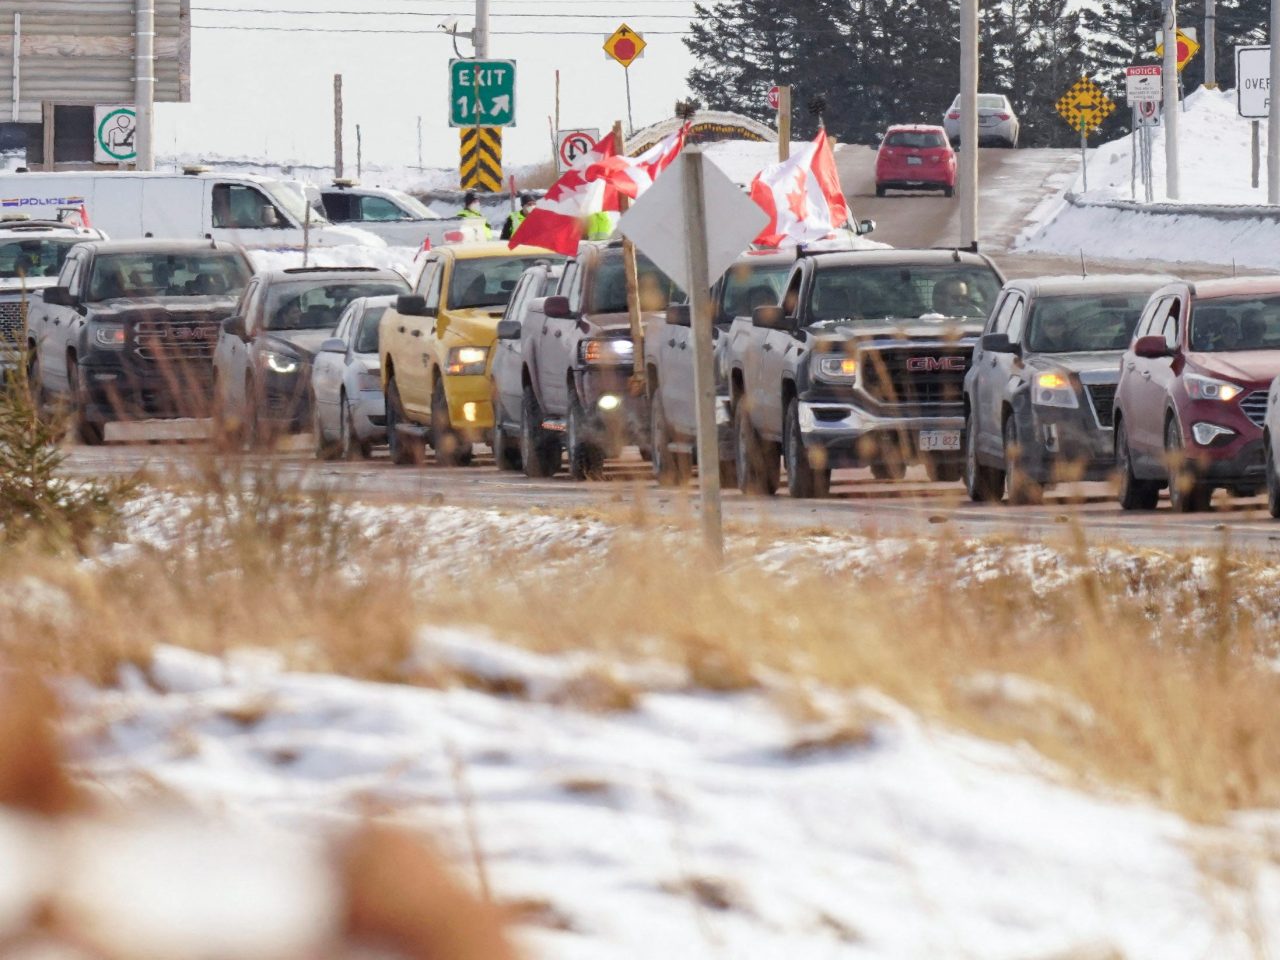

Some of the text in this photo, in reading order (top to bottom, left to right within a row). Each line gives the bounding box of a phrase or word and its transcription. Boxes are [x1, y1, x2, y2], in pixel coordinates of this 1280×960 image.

[458, 69, 506, 87] EXIT
[1129, 67, 1158, 76] NOTICE
[456, 95, 487, 119] 1A
[20, 197, 66, 207] POLICE
[167, 327, 218, 339] GMC
[906, 356, 966, 372] GMC
